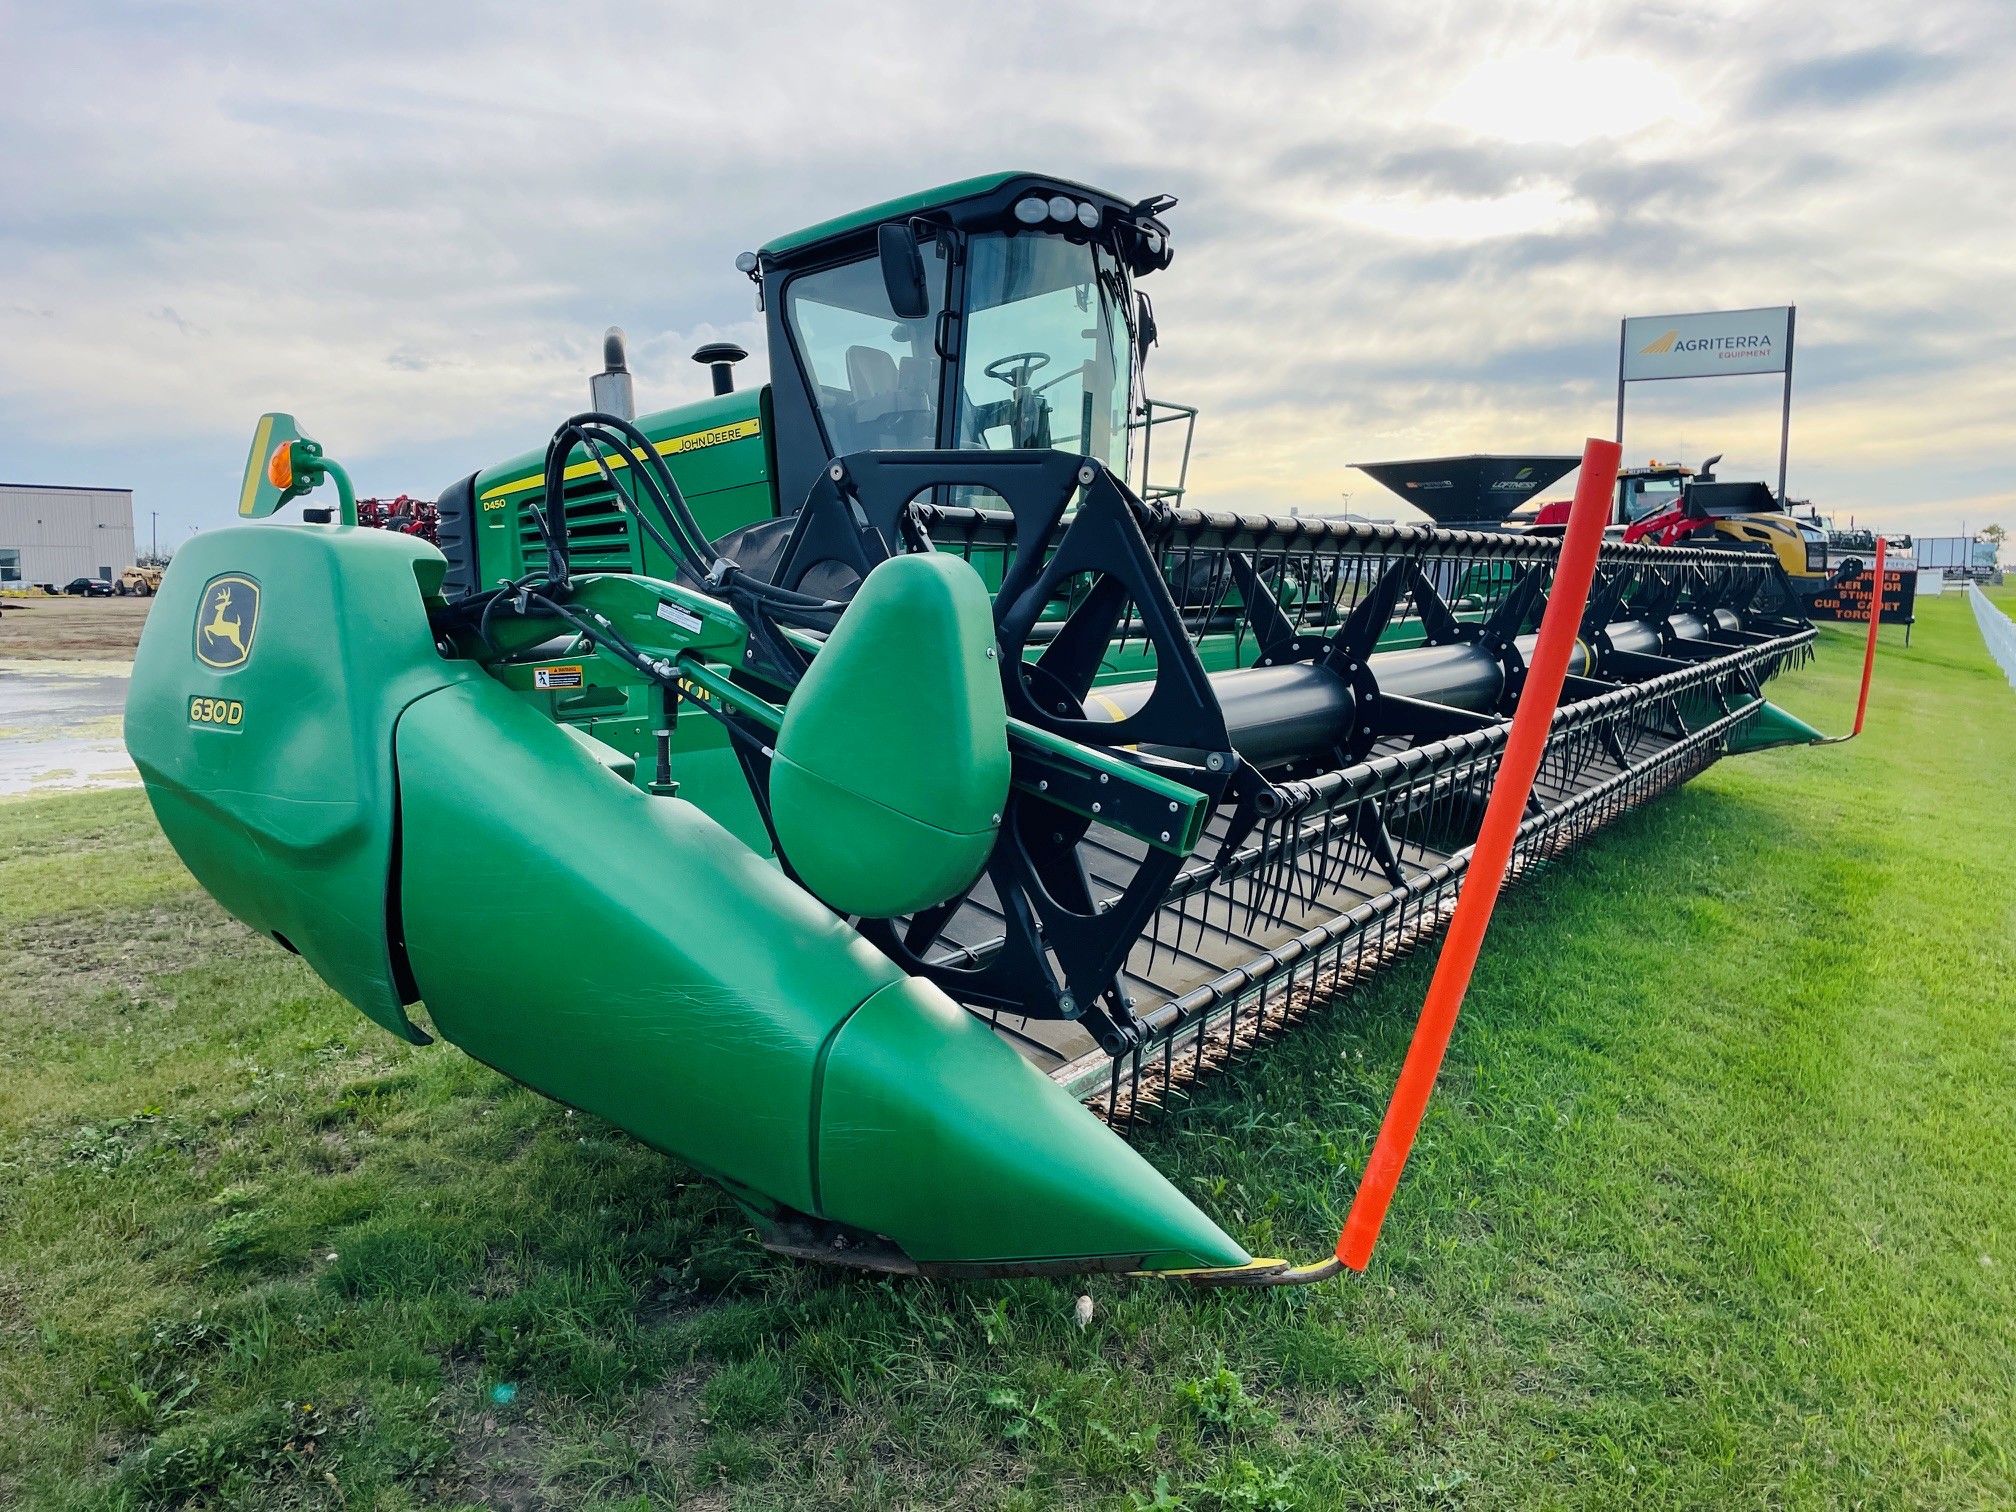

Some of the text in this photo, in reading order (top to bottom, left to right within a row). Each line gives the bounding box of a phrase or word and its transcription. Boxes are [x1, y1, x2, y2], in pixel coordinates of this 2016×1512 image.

[1674, 334, 1772, 353] AGRITERRA
[1718, 348, 1772, 360] EQUIPMENT
[678, 427, 742, 452] JOHN DEERE
[1492, 480, 1538, 490] LOFTNESS
[483, 498, 507, 512] D450
[1814, 599, 1840, 609] CUB
[190, 697, 243, 725] 630D
